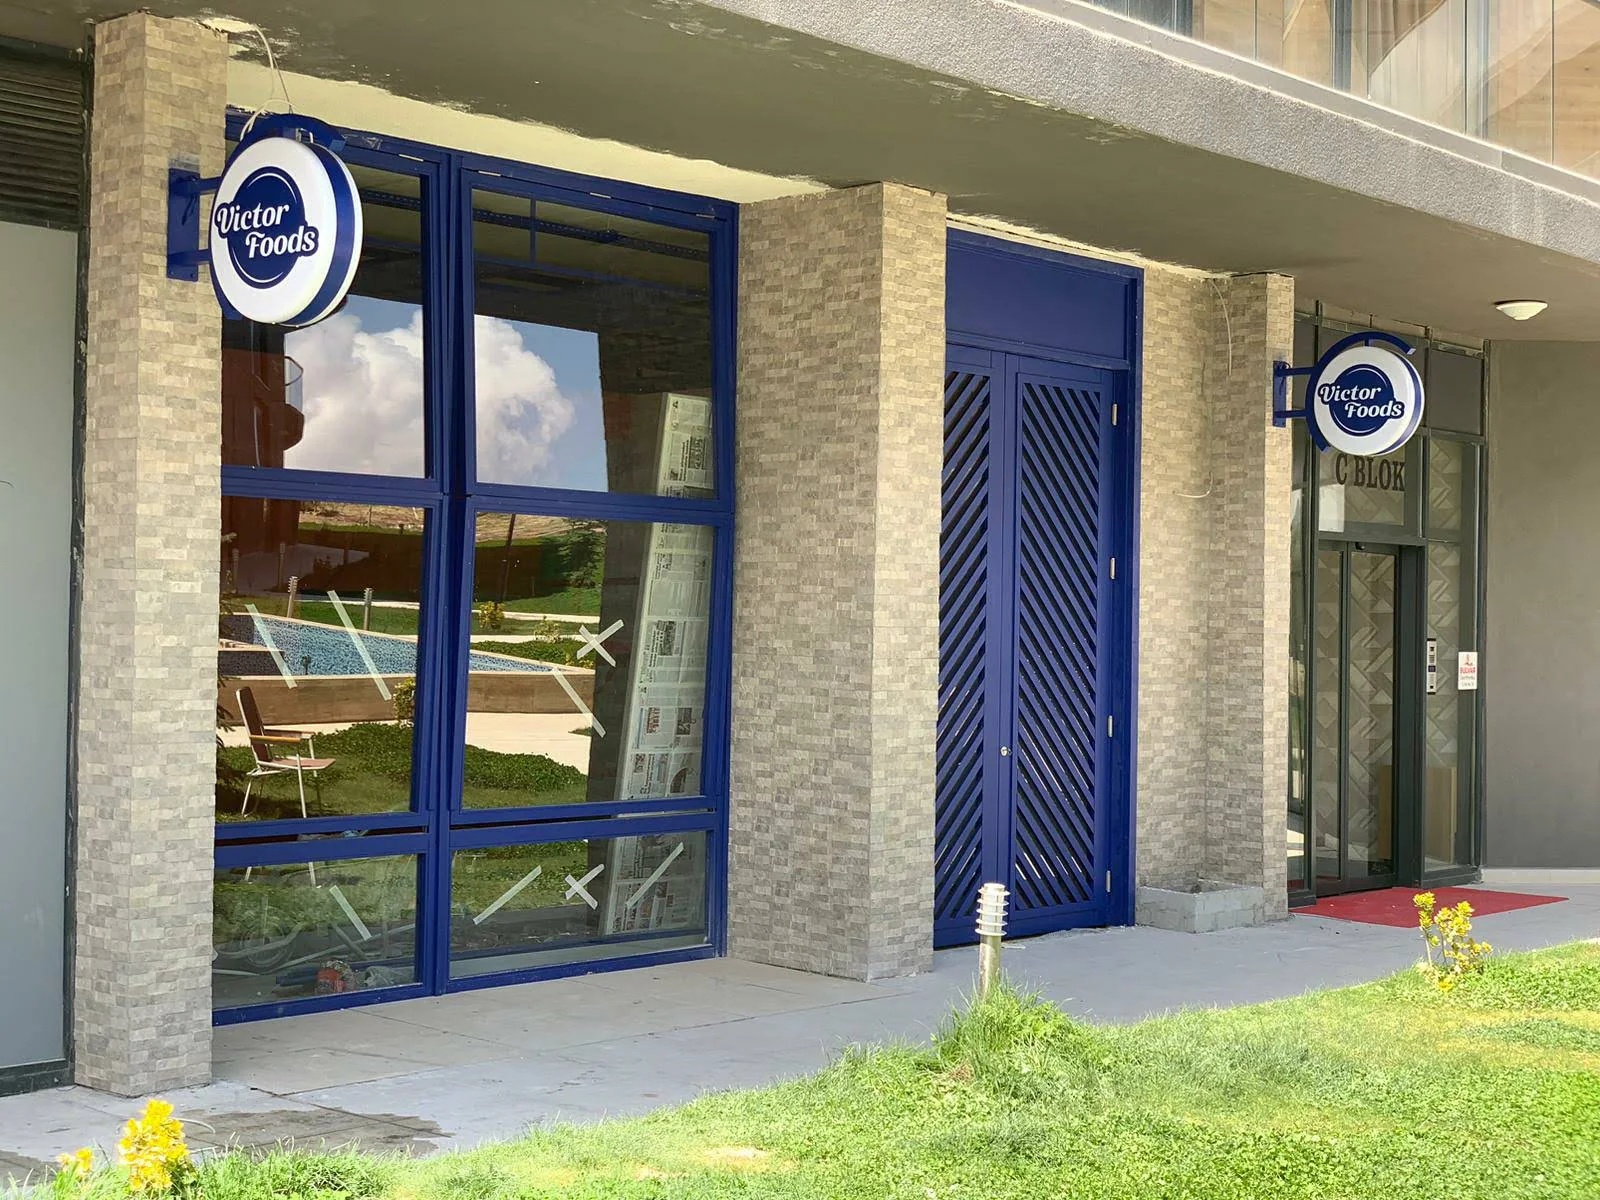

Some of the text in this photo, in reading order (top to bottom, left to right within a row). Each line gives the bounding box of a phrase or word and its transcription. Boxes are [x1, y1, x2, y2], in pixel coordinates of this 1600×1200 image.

[217, 202, 290, 234] Victor
[245, 225, 316, 259] Foods
[1319, 385, 1382, 402] Victor
[1344, 400, 1403, 418] Foods
[1335, 453, 1405, 491] C BLOK
